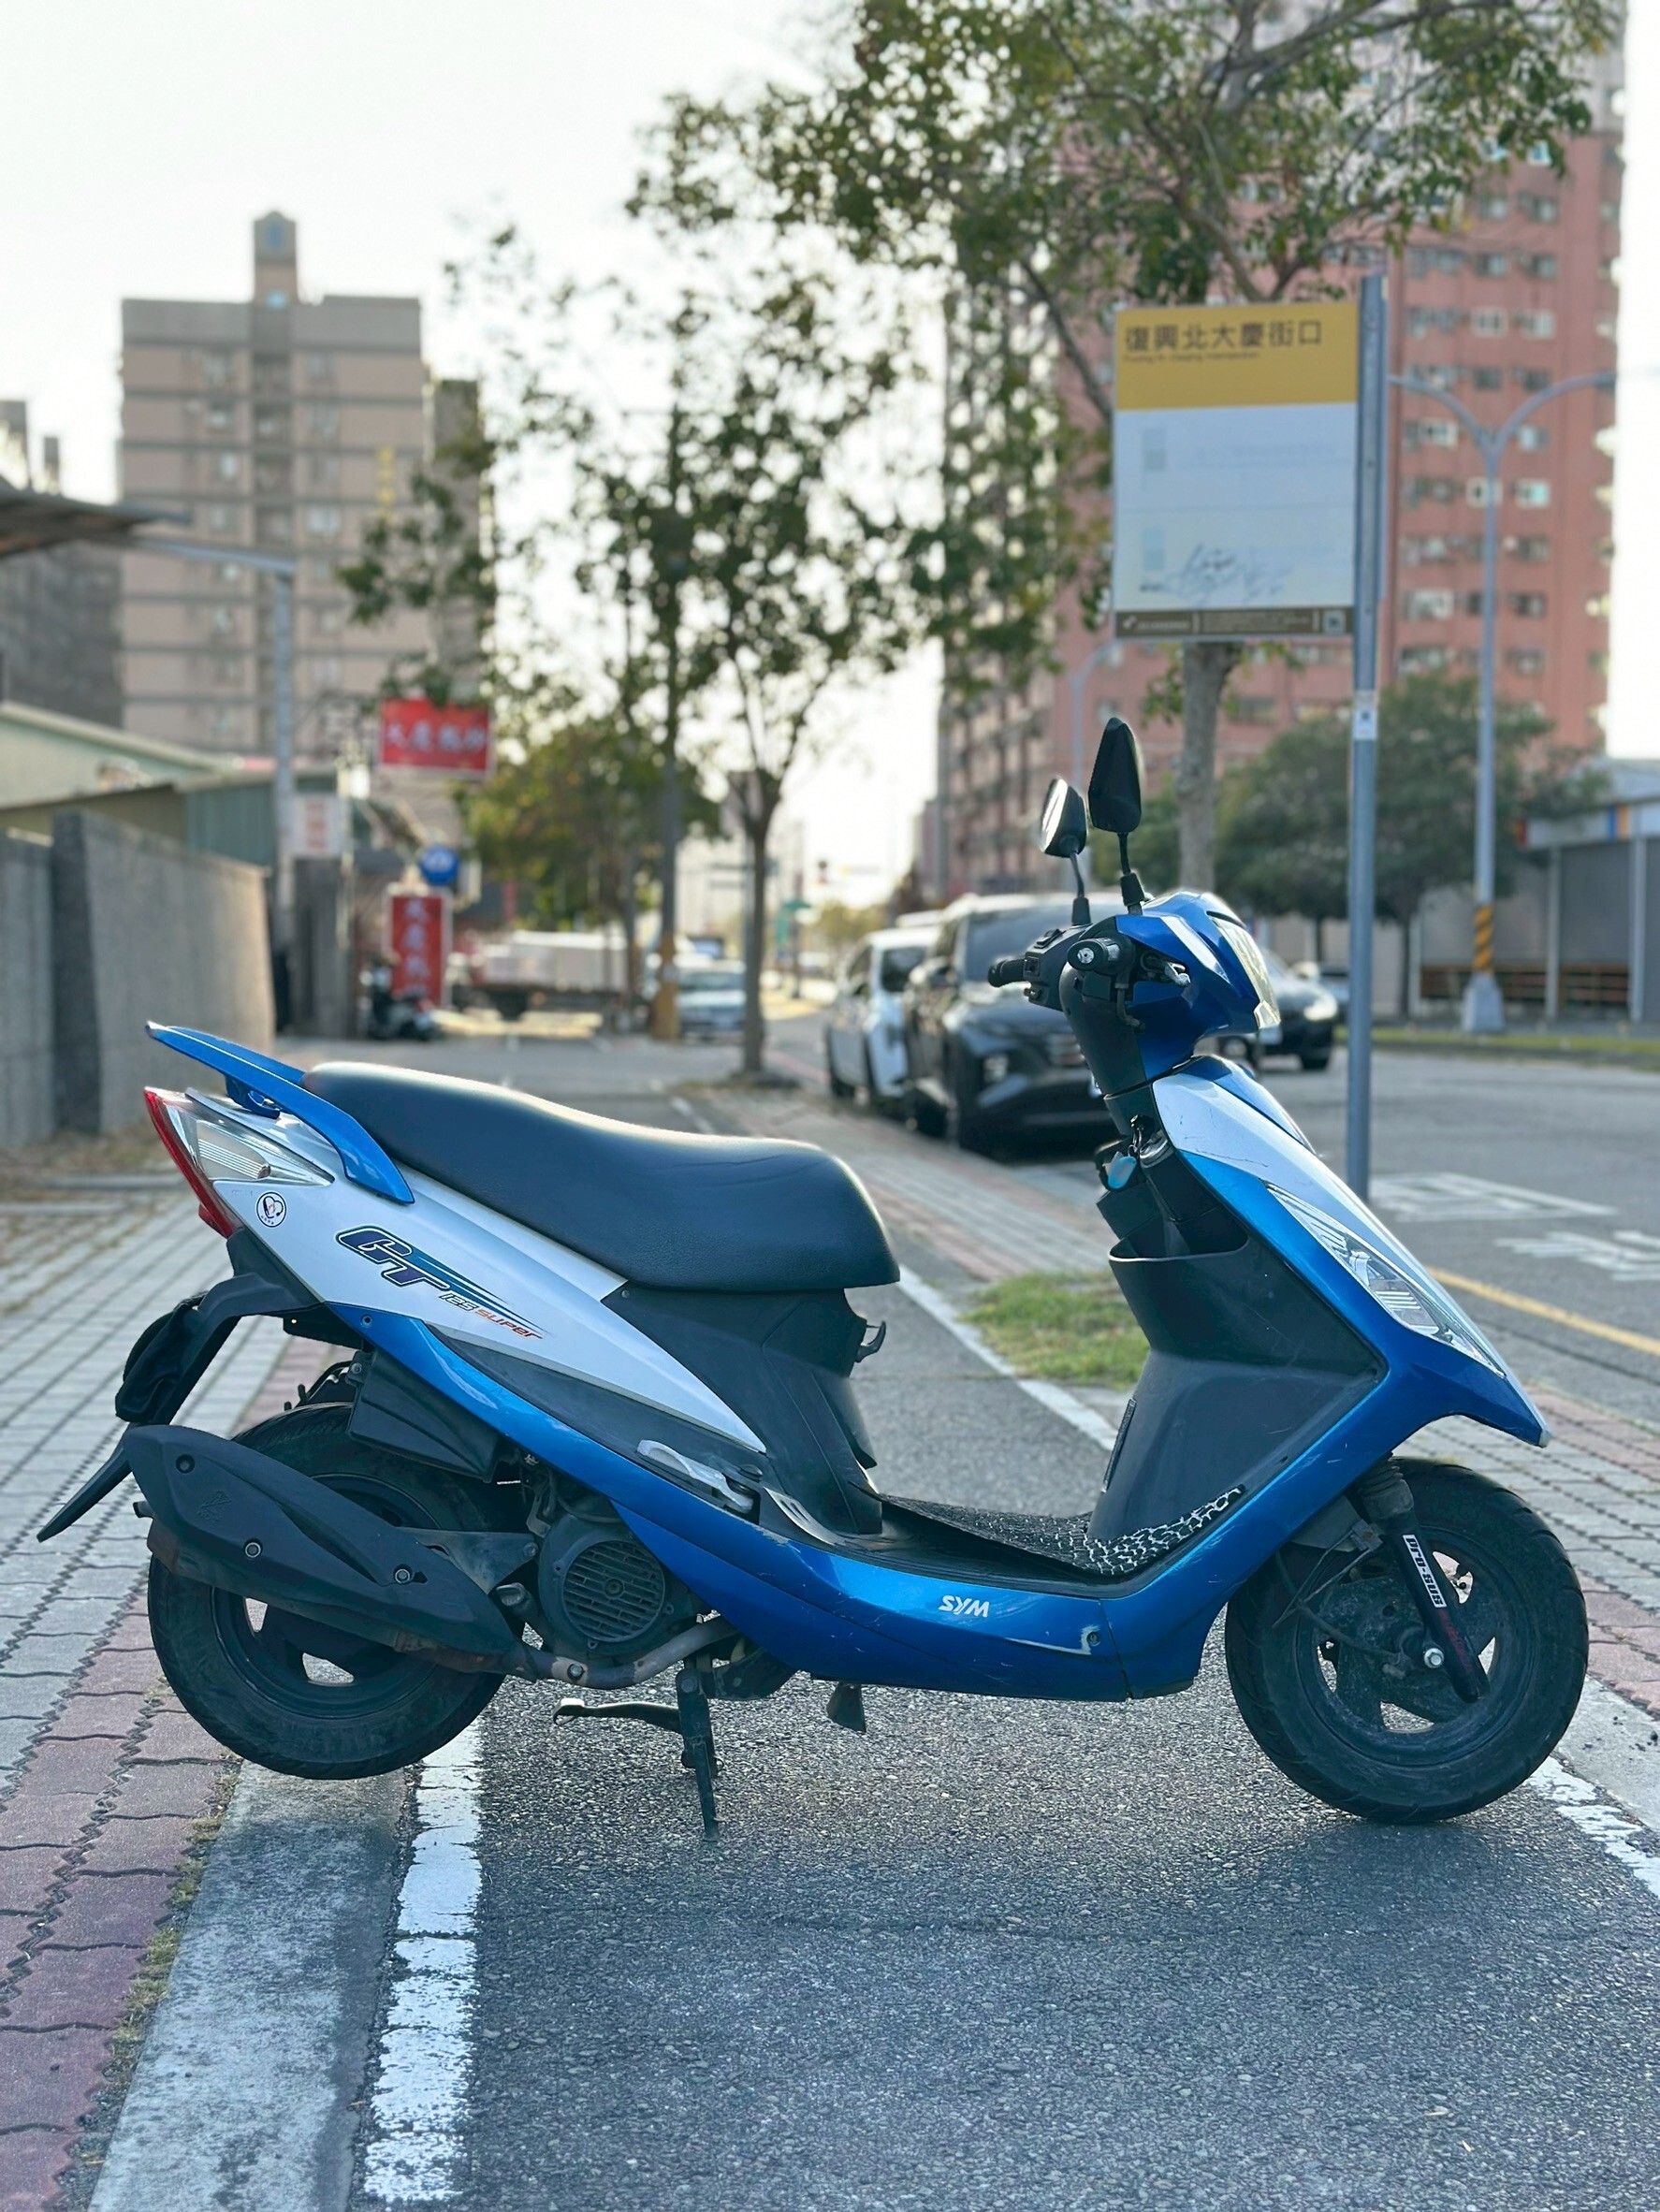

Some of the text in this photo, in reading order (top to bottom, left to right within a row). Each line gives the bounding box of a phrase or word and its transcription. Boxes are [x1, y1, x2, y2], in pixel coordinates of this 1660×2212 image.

[1125, 319, 1322, 351] 復興北大慶街口
[335, 1225, 451, 1288] GT
[439, 1292, 479, 1312] 125
[939, 1594, 990, 1618] SYM
